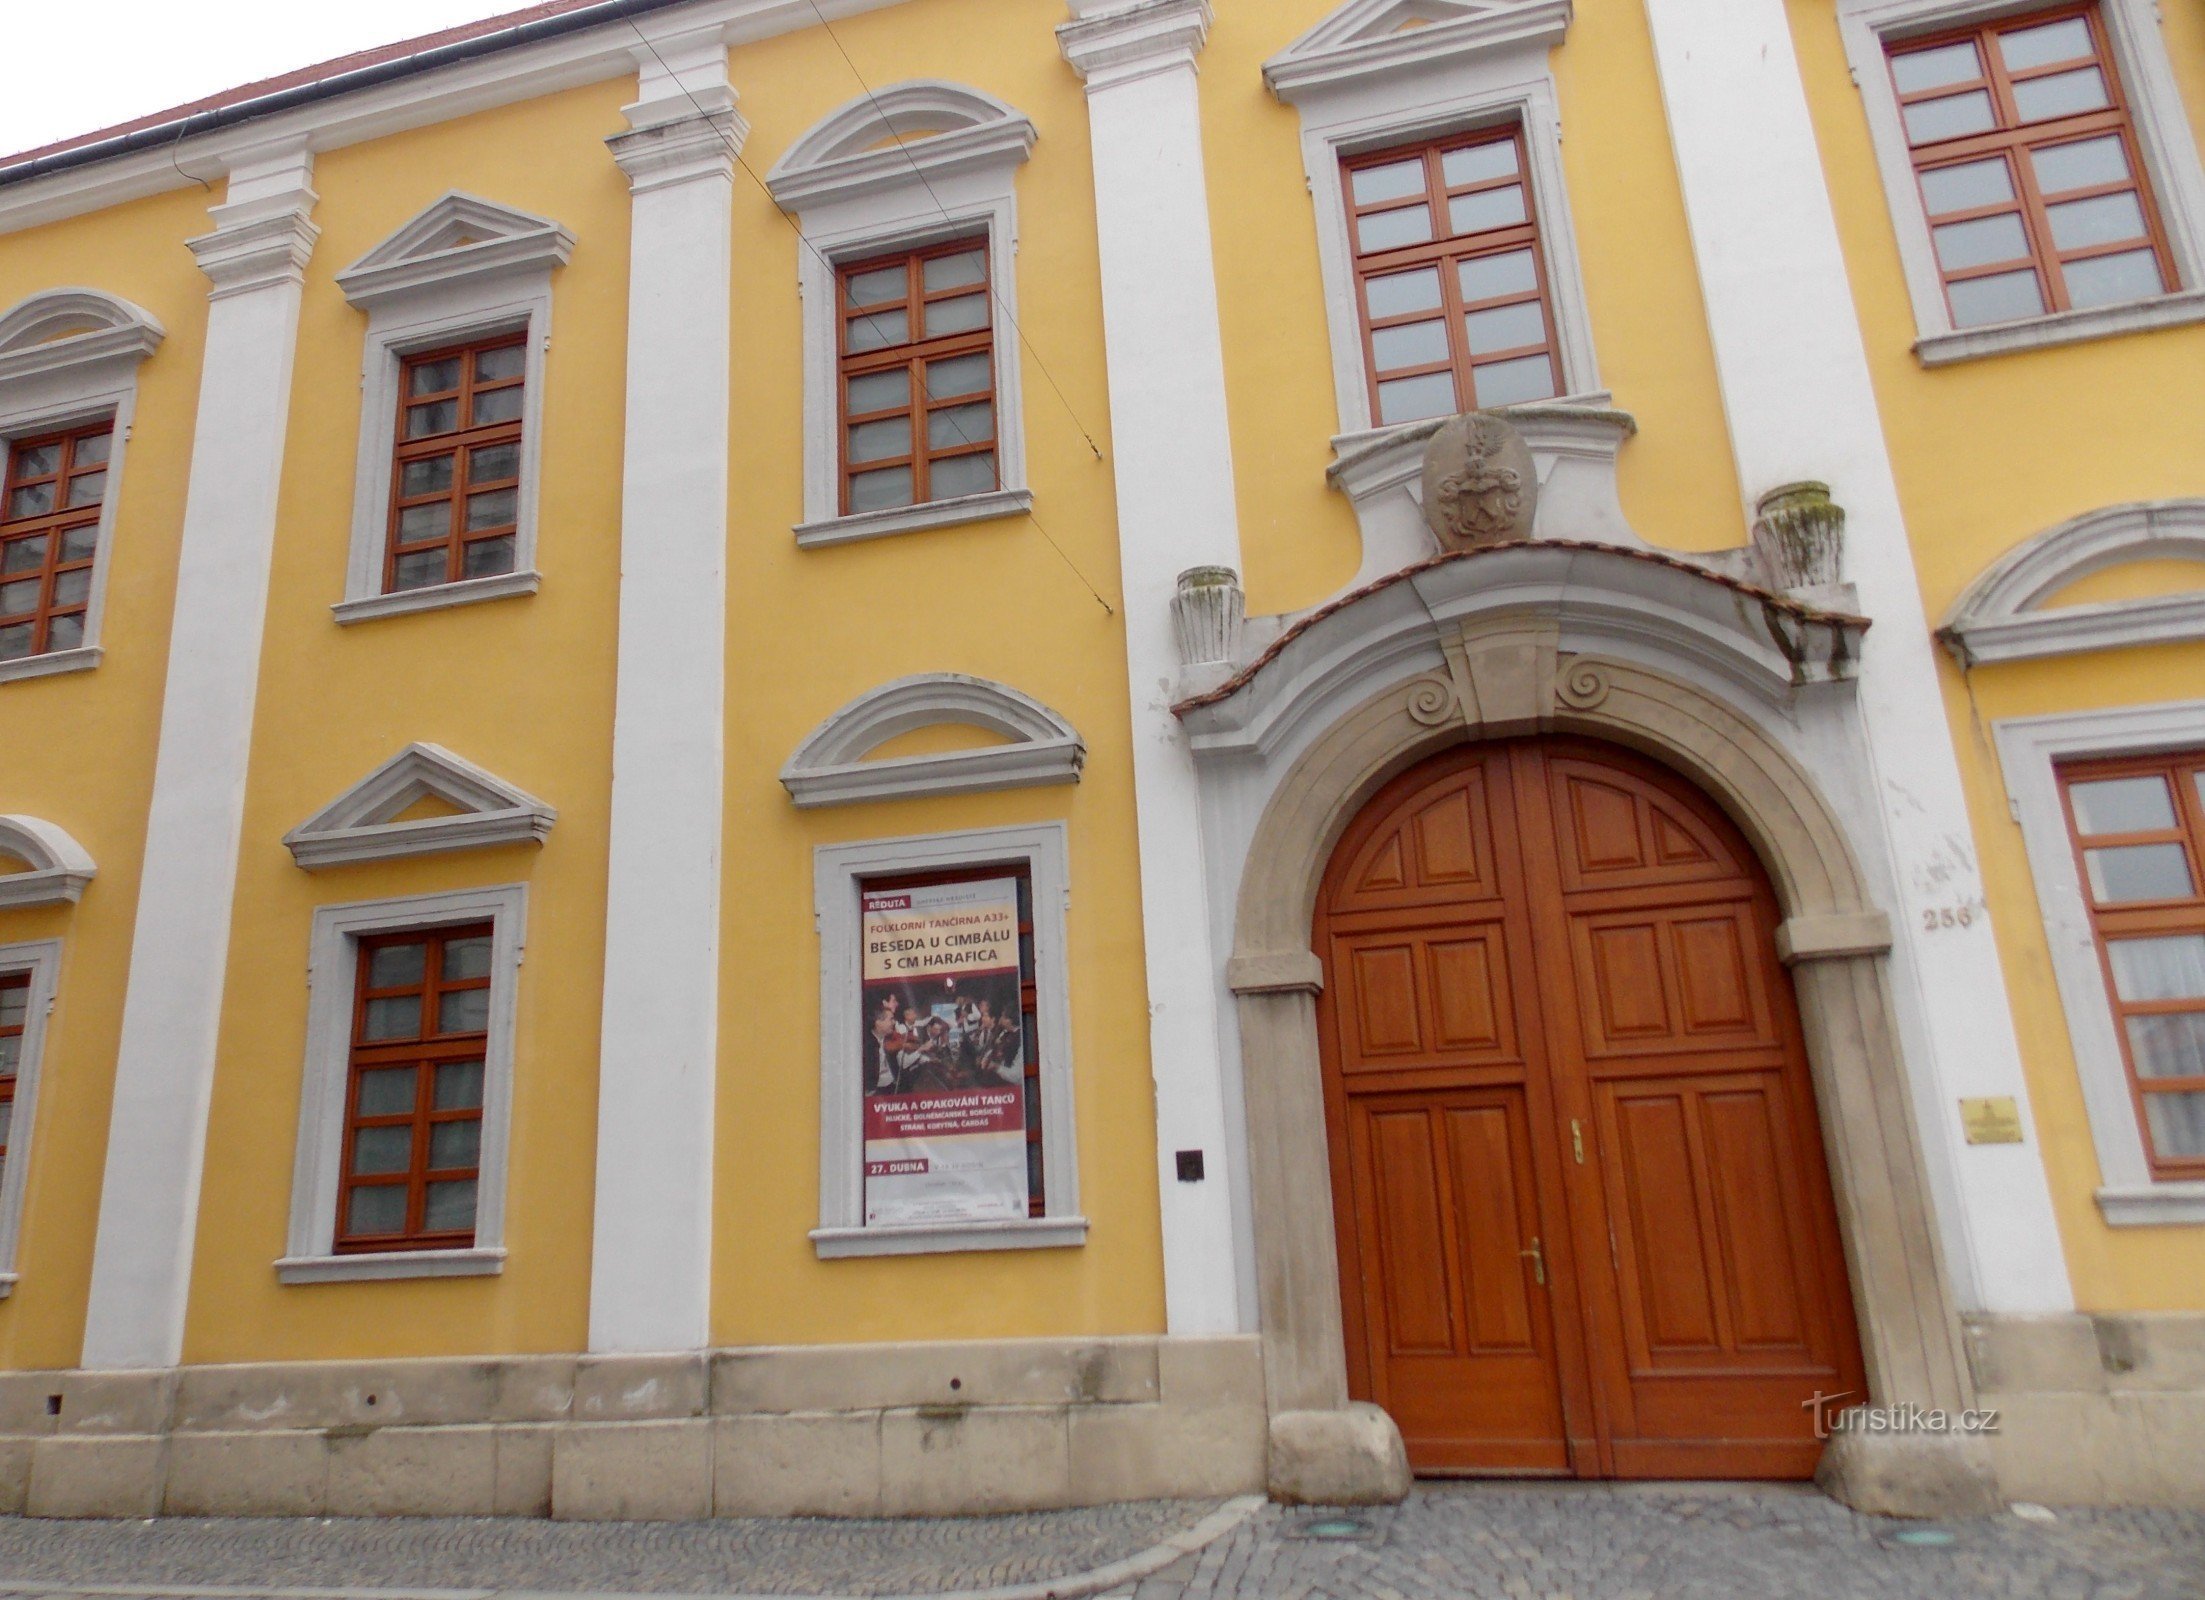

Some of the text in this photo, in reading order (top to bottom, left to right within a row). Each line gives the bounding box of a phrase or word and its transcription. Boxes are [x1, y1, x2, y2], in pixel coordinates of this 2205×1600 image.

[869, 899, 906, 910] REDUTA
[870, 920, 926, 933] FOLKLORNÍ
[984, 912, 1010, 923] A33+
[1923, 907, 1972, 931] 256
[870, 929, 1010, 953] BESEDA U CIMBÁLU
[884, 949, 998, 970] S CM HARAFICA
[911, 1101, 918, 1110] A
[920, 1096, 979, 1110] OPAKOVÁNÍ
[871, 1164, 887, 1174] 27.
[889, 1162, 925, 1173] DUBNA
